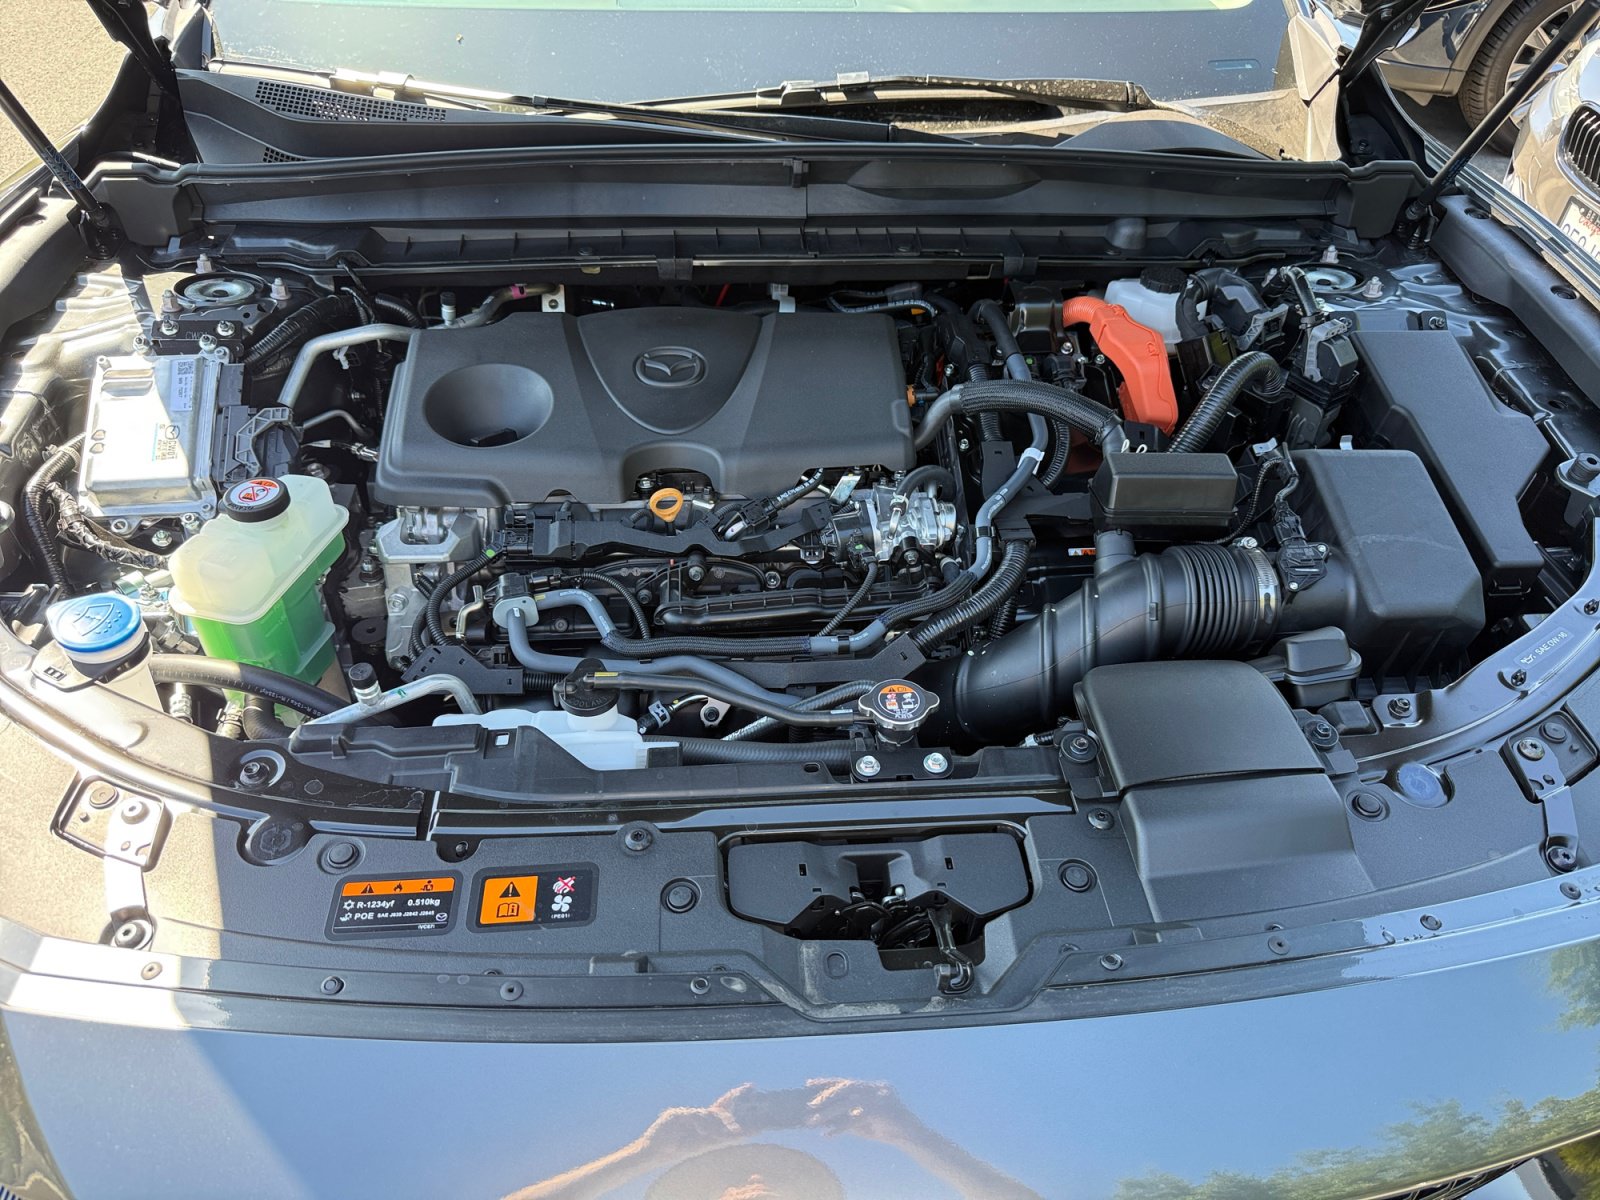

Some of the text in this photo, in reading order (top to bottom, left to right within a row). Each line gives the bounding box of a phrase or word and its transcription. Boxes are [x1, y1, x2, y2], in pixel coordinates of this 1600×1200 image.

[1534, 643, 1551, 655] SAE
[356, 898, 441, 909] R-1234yf 0.510kg
[354, 912, 375, 920] POE
